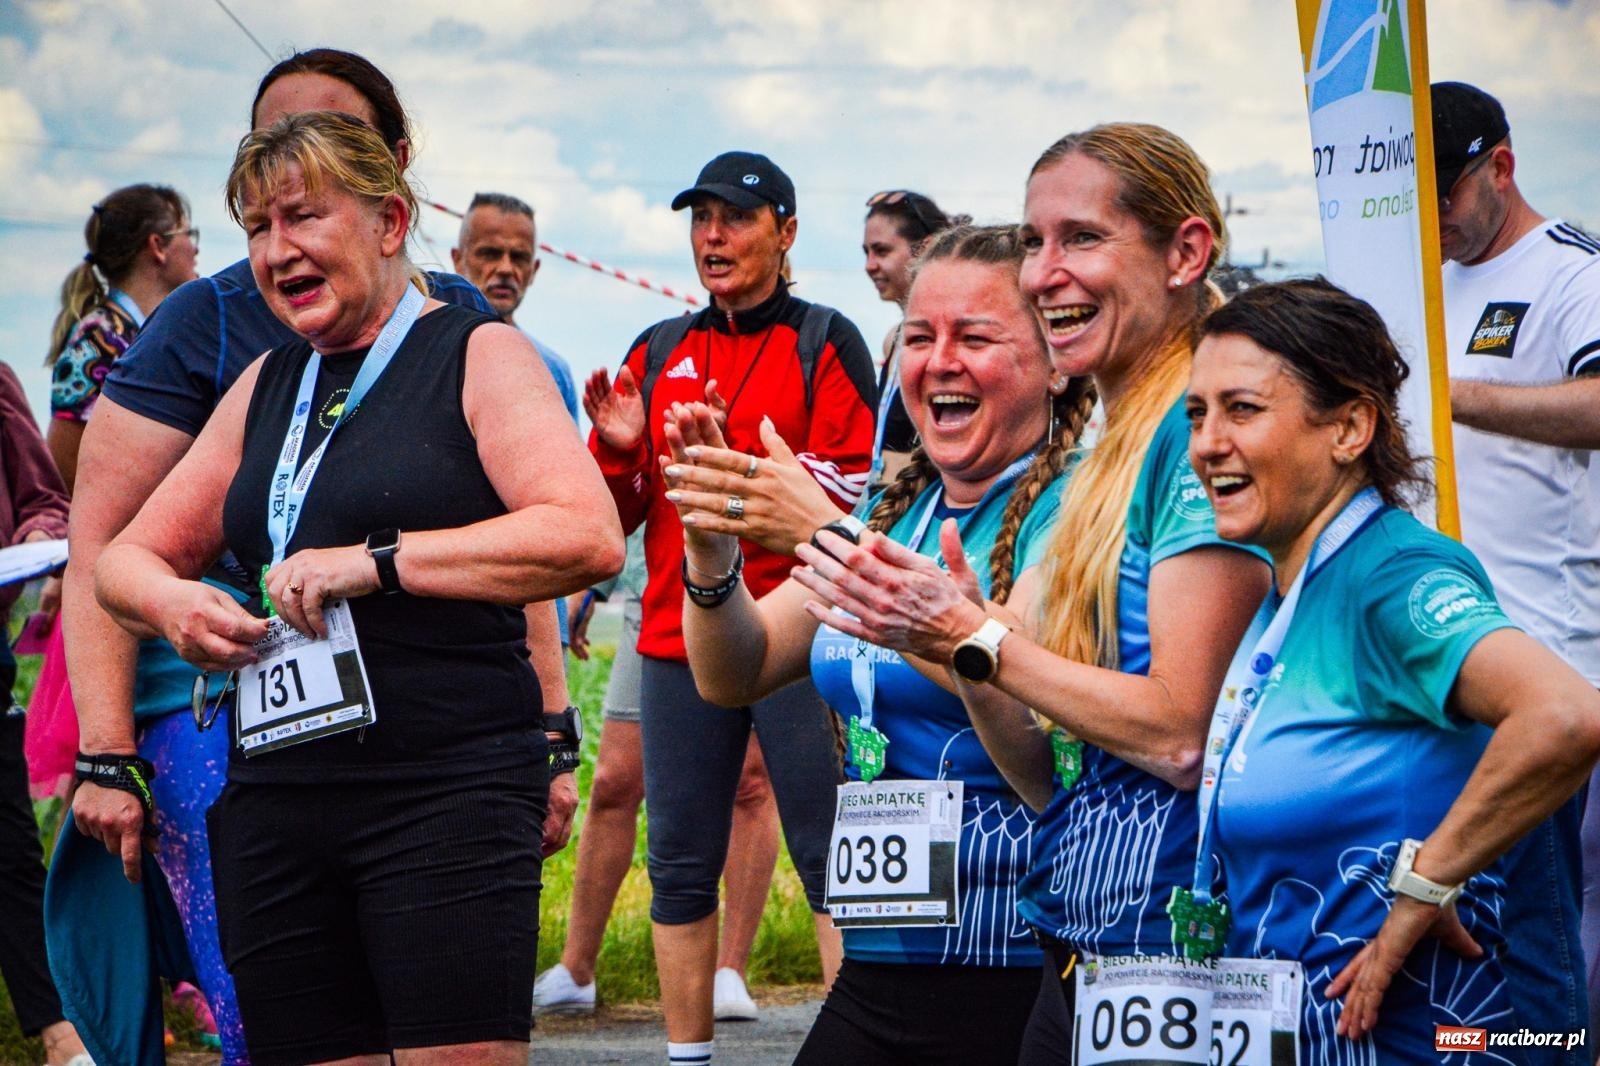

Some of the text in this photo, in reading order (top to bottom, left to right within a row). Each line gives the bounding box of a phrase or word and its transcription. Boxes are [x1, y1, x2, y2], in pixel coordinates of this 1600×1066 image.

[1474, 325, 1515, 340] SPIKER
[666, 370, 698, 380] adidas
[258, 658, 306, 713] 131
[860, 793, 874, 806] NA
[876, 792, 926, 808] PIĄTKĘ
[837, 834, 908, 884] 038
[1092, 996, 1198, 1051] 068
